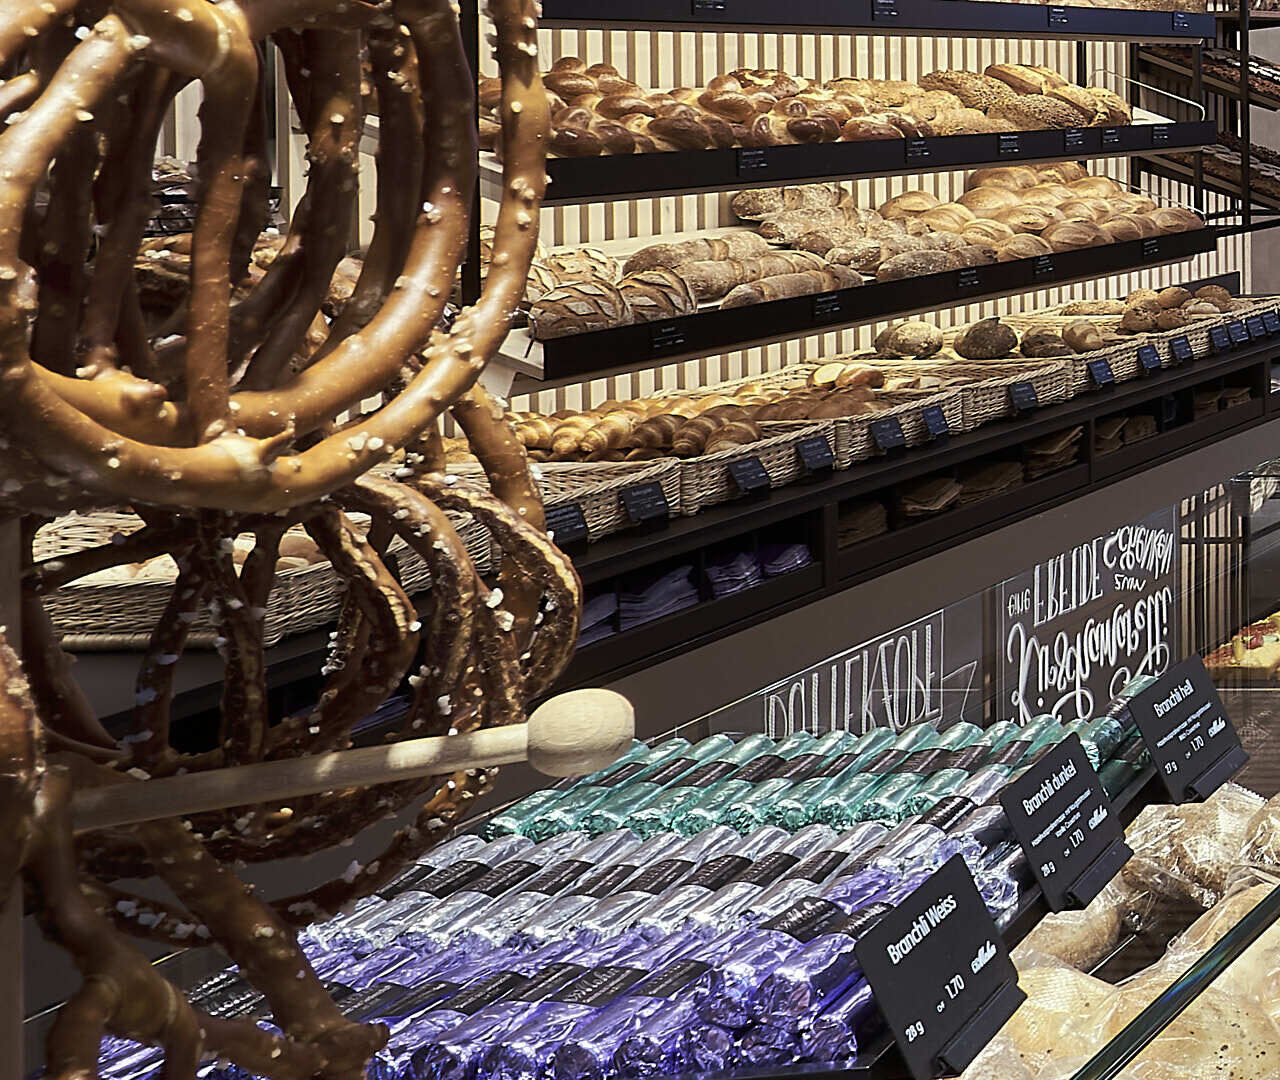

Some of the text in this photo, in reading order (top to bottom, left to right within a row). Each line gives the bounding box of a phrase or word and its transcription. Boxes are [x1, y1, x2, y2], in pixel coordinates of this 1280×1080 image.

[1153, 678, 1194, 718] Branchli hell
[1190, 736, 1204, 752] 1.70
[1022, 759, 1077, 816] Branchli dunkel
[1069, 828, 1085, 848] 1.70
[887, 894, 957, 964] Branchli Weiss
[905, 1026, 916, 1042] 28
[916, 1020, 925, 1035] g
[945, 974, 965, 999] 1.70
